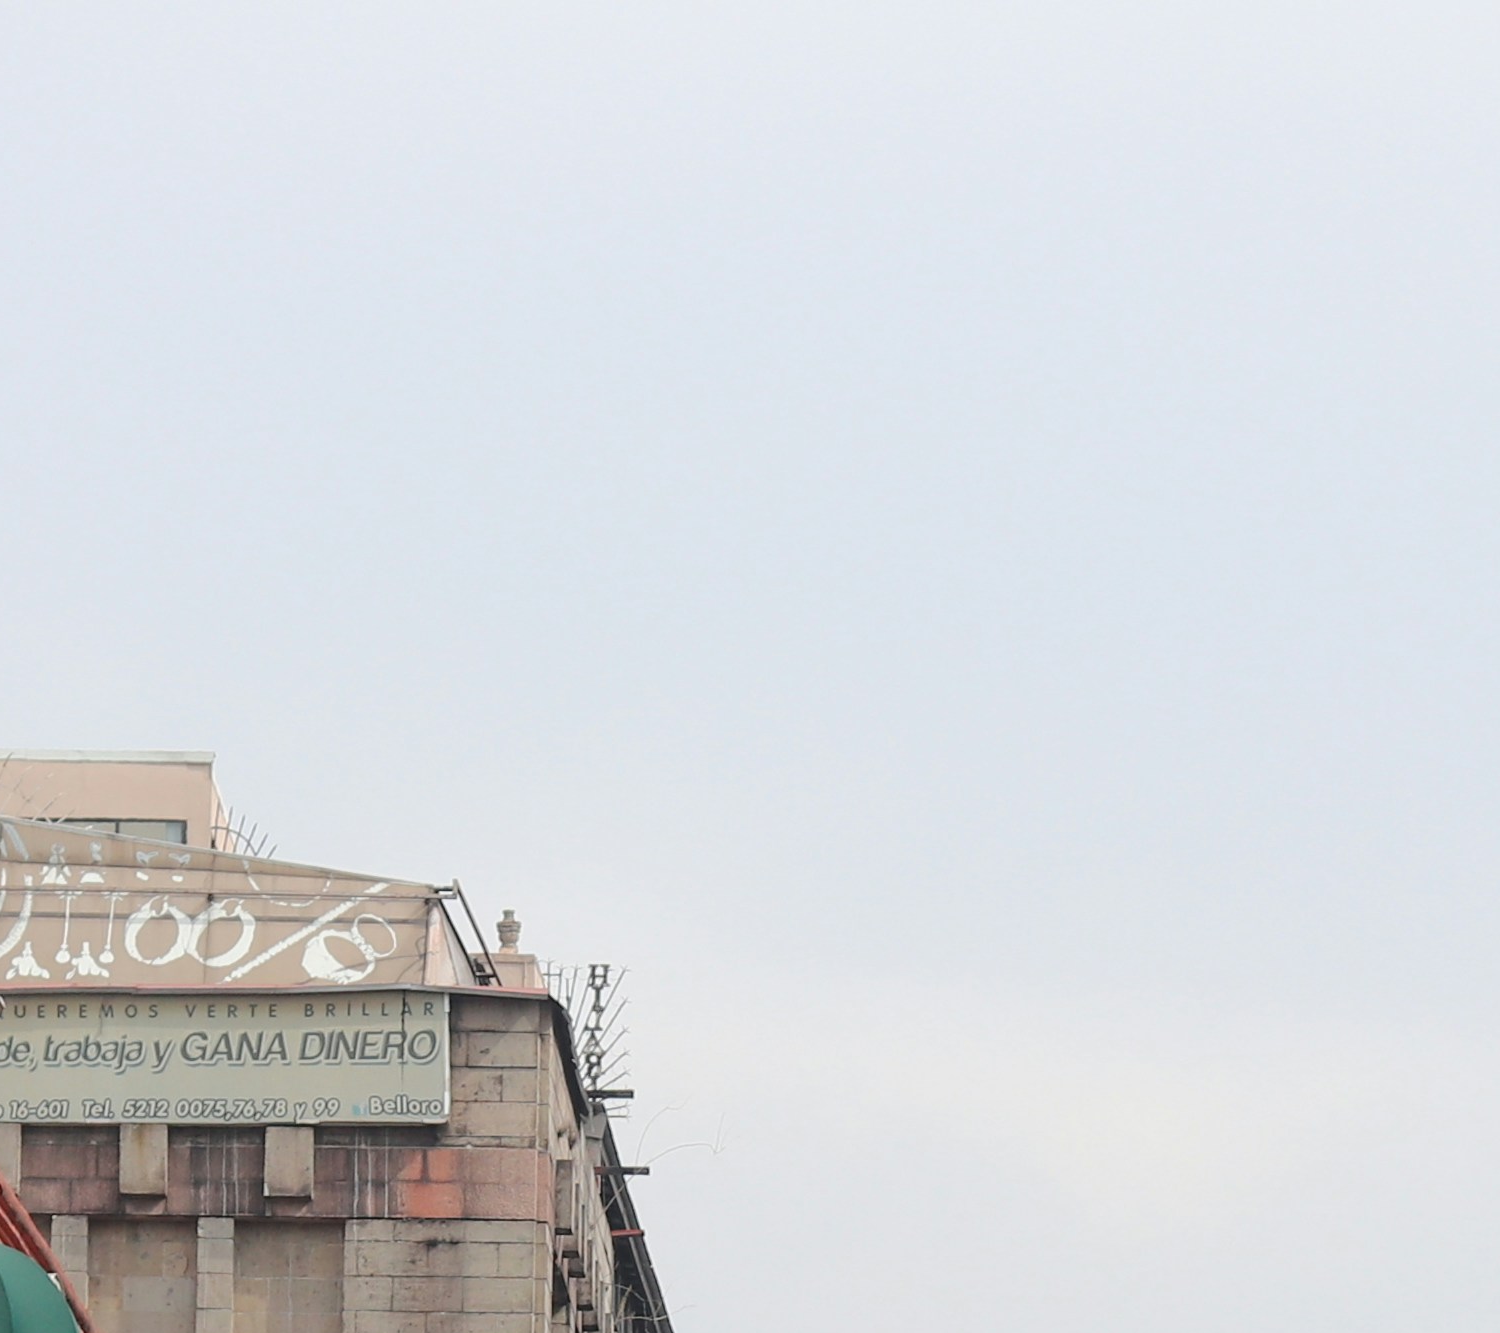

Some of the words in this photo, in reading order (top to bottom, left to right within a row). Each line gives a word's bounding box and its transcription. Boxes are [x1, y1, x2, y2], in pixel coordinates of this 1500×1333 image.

[185, 1003, 279, 1018] VERTE
[43, 1033, 147, 1074] trabaja
[152, 1040, 175, 1072] y
[180, 1030, 288, 1065] GANA
[298, 1029, 439, 1066] DINERO
[8, 1100, 70, 1119] 16-601
[81, 1101, 114, 1119] Tel.
[121, 1100, 169, 1118] 5212
[175, 1099, 287, 1121] 0075,76,78
[293, 1104, 307, 1122] y
[314, 1099, 340, 1117] 99
[368, 1096, 443, 1116] Belloro
